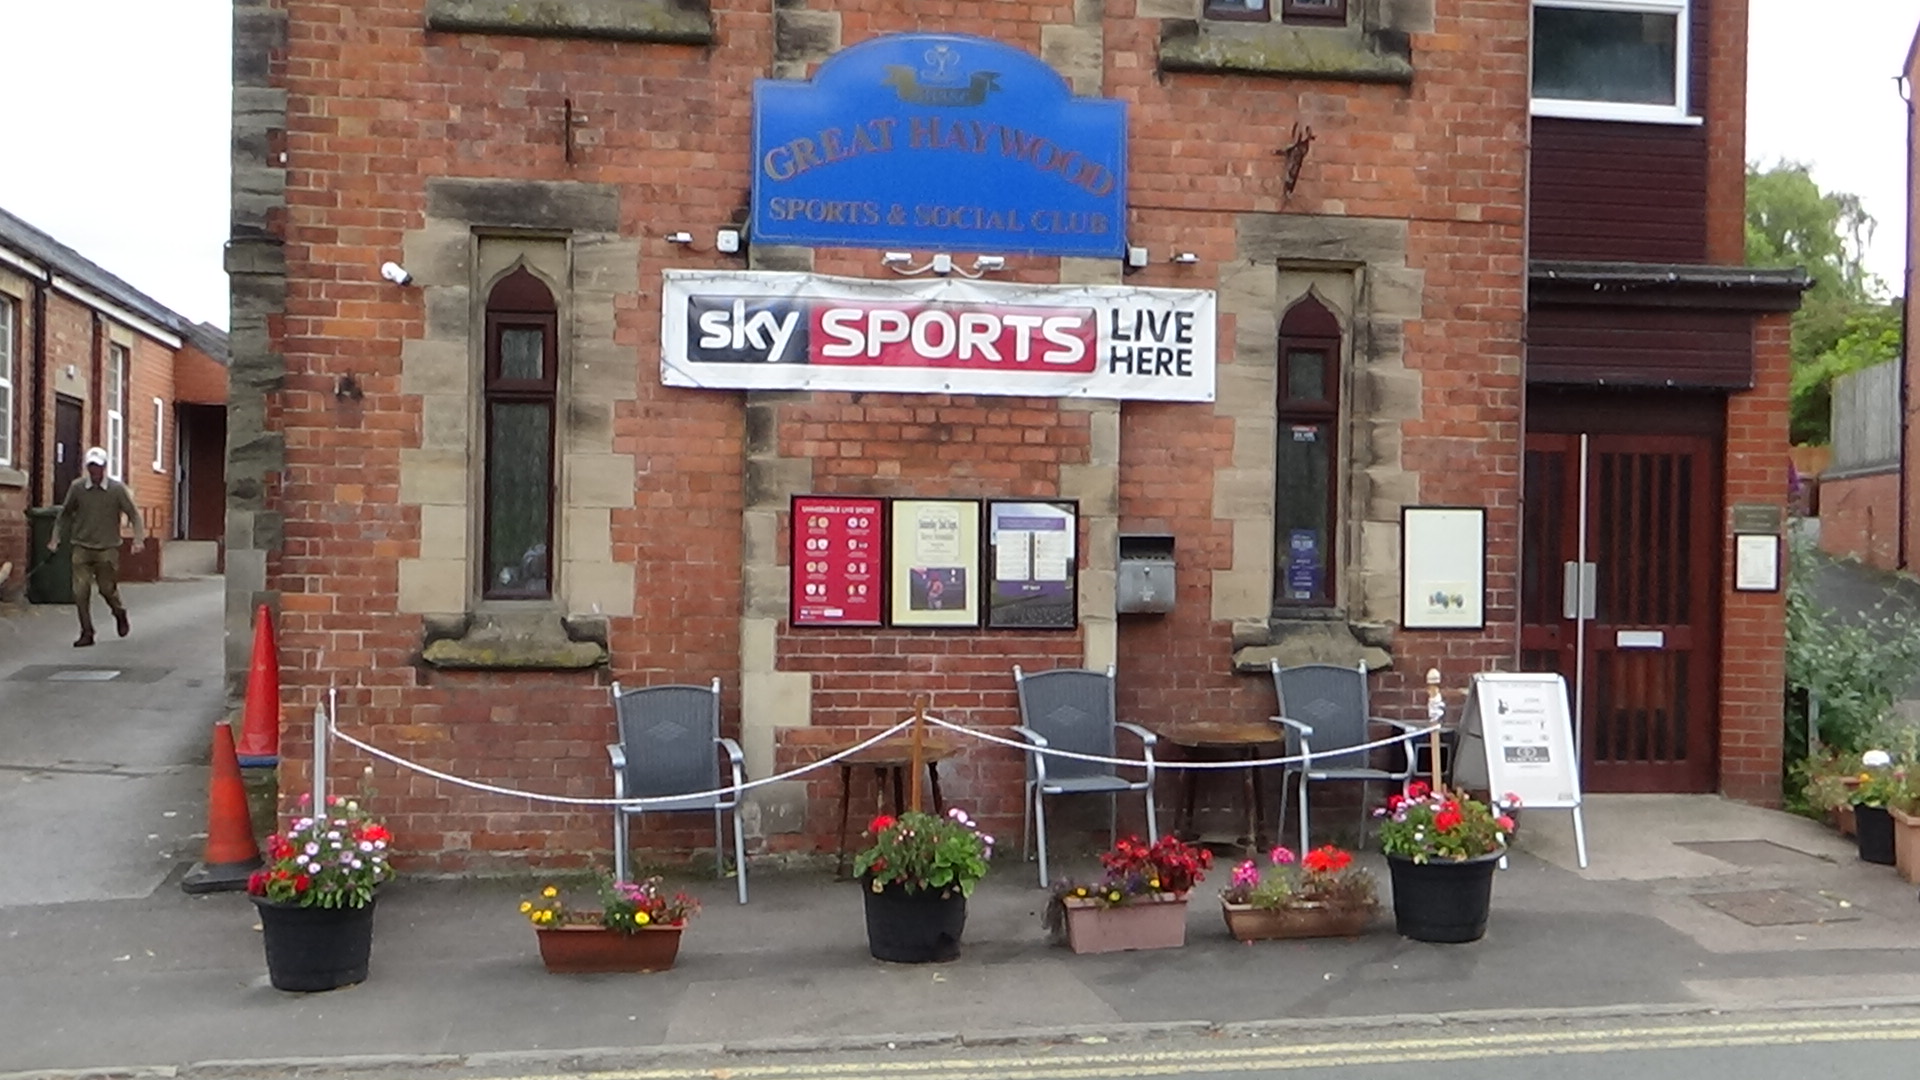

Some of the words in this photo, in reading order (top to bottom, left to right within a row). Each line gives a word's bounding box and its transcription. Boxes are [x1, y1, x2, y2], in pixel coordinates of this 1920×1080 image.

[764, 117, 898, 182] GREAT
[909, 117, 1114, 197] HAYWOOD
[769, 197, 879, 225] SPORTS
[886, 205, 906, 226] &
[914, 205, 1026, 232] SOCIAL
[1031, 210, 1110, 235] CLUB
[698, 299, 800, 361] sky
[821, 309, 1084, 365] SPORTS
[1110, 308, 1194, 344] LIVE
[1109, 346, 1194, 378] HERE
